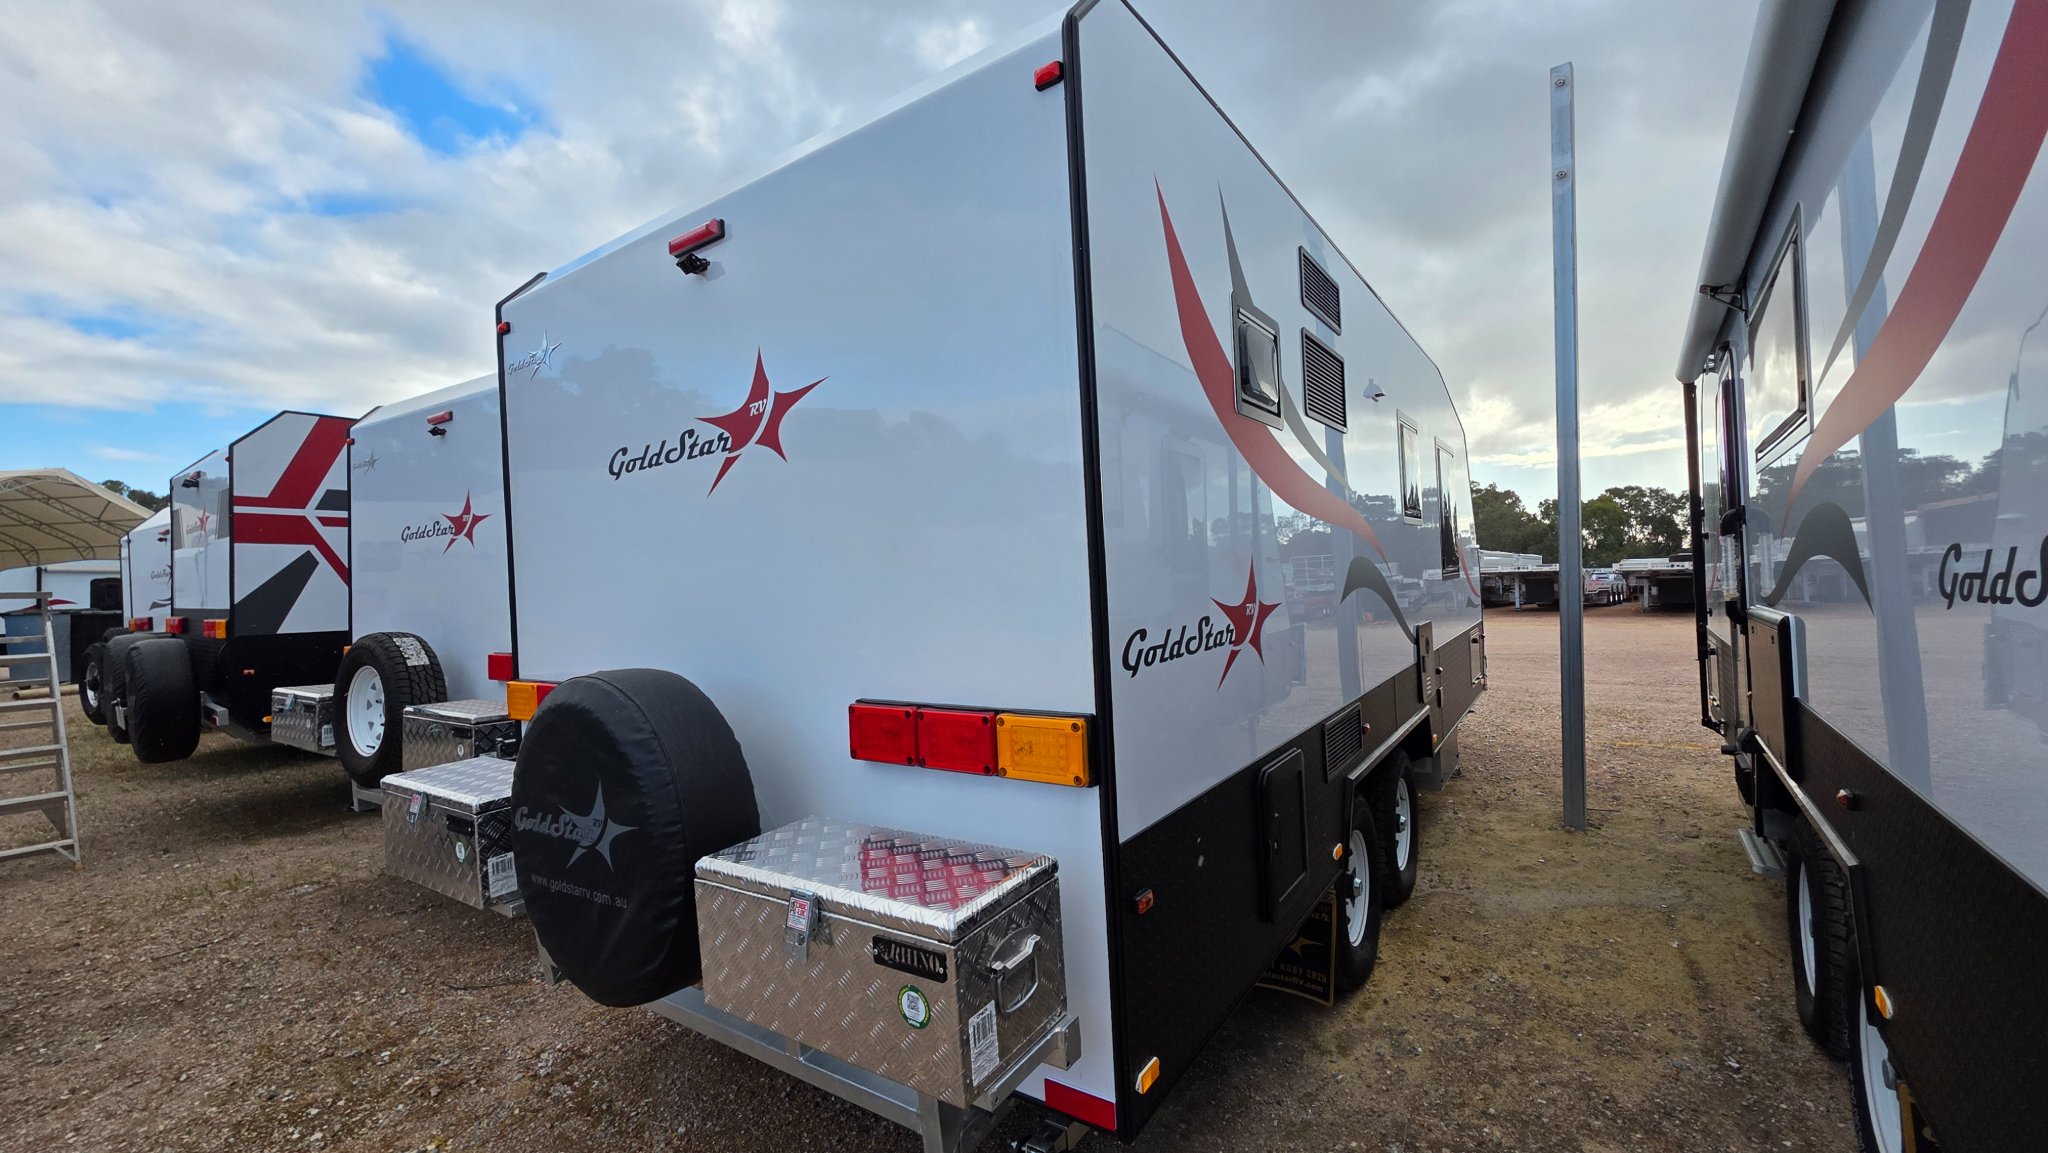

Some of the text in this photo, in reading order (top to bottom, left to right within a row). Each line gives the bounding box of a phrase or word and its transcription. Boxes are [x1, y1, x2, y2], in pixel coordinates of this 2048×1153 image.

[609, 399, 767, 480] GoldStar RV
[401, 520, 455, 543] GoldStar
[1122, 615, 1235, 679] GoldStar
[515, 806, 594, 842] GoldStar
[531, 873, 627, 909] www.goldstarrv.com.au
[889, 943, 940, 974] RHINO
